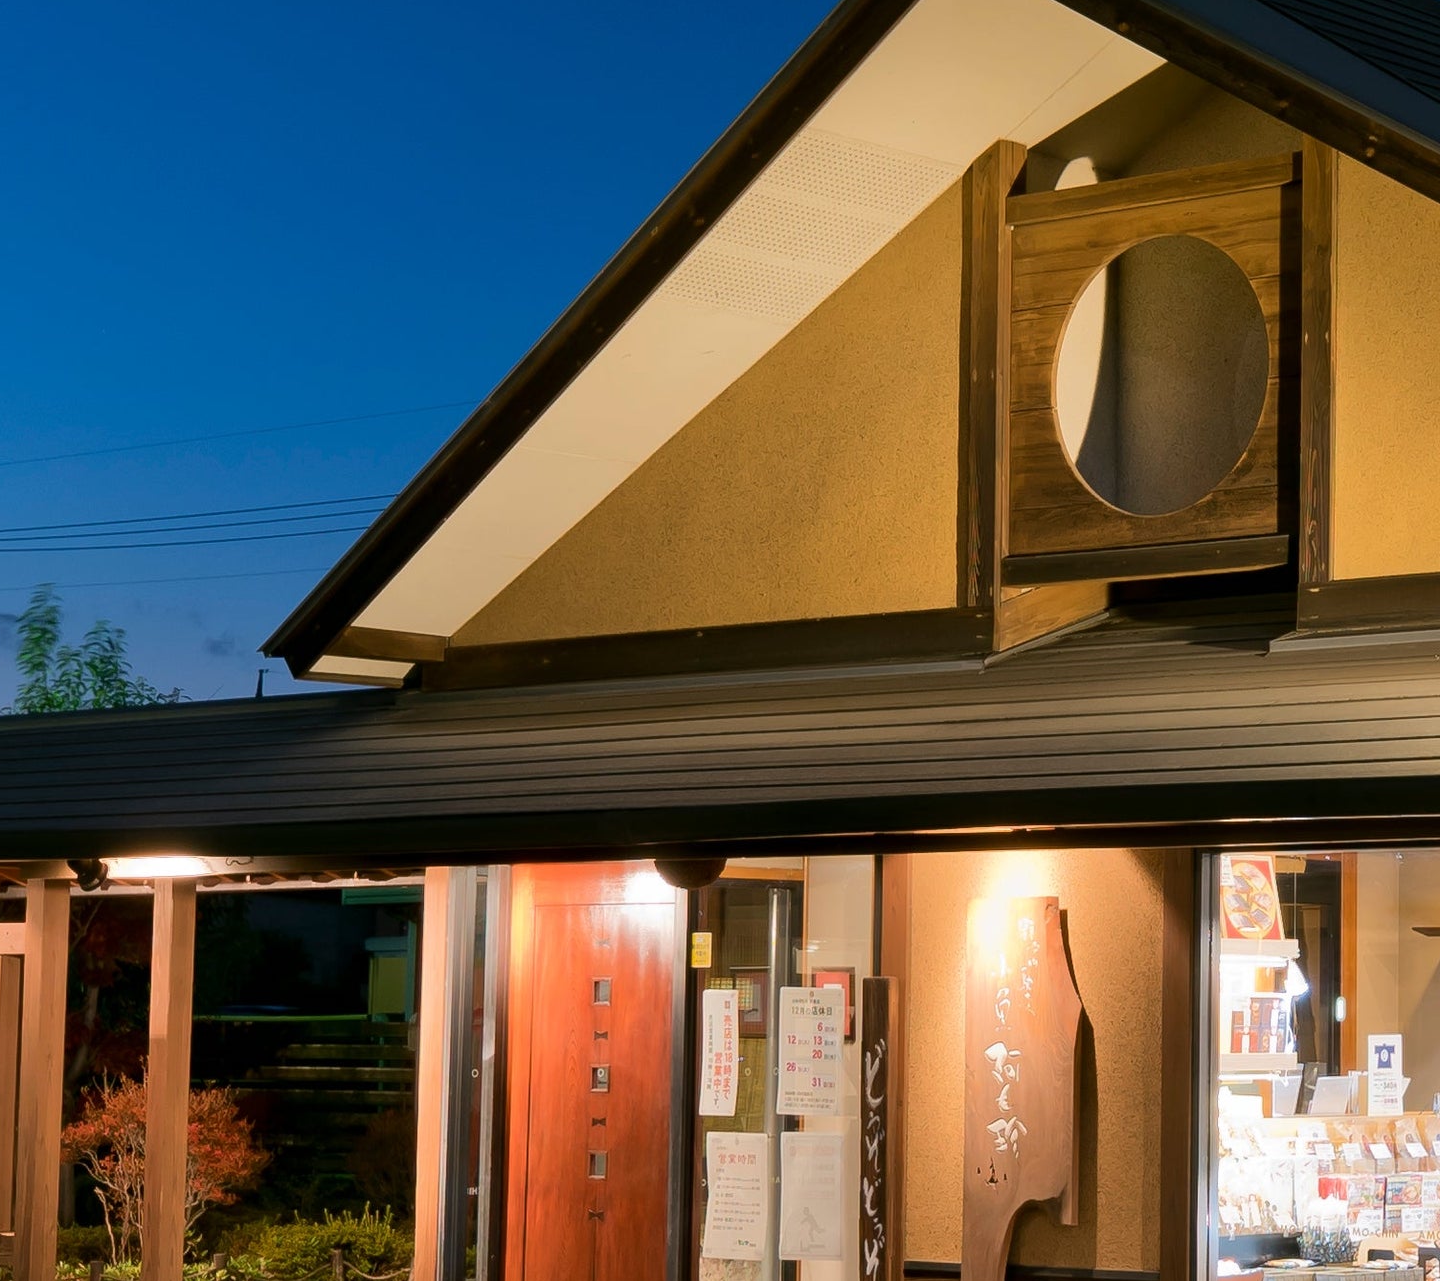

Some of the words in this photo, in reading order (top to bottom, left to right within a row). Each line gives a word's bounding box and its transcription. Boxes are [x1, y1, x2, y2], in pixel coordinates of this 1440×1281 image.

[718, 1153, 757, 1166] 営業時間
[1344, 1227, 1399, 1238] AMO-CHIN
